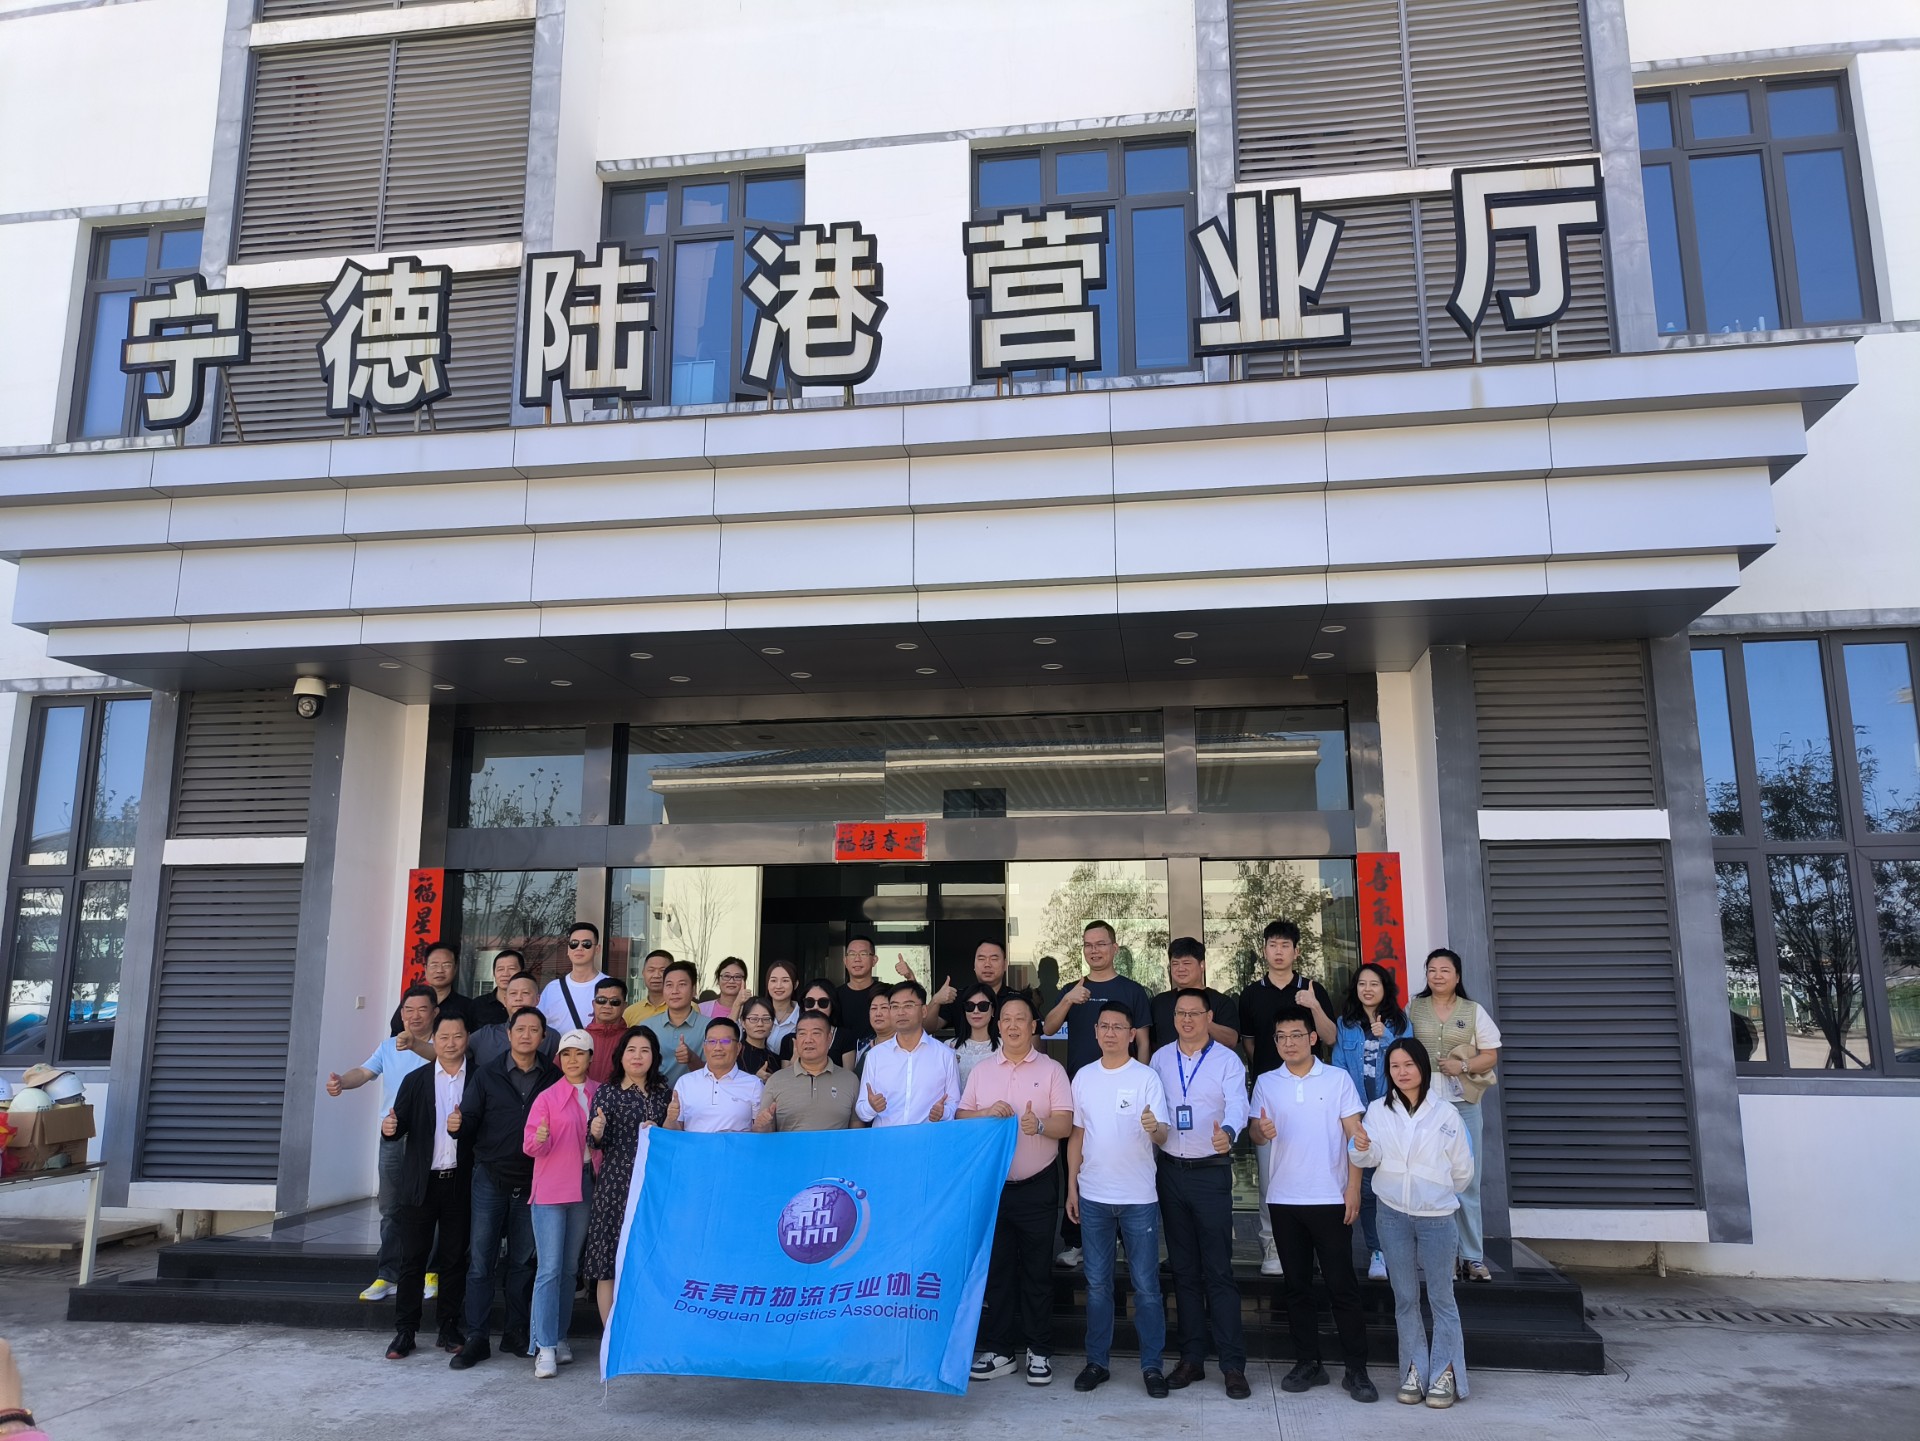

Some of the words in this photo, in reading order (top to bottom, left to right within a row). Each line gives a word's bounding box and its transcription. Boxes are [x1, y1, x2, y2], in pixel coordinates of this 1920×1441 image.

[121, 157, 1603, 429] 宁德陆港营业厅
[680, 1272, 942, 1307] 东莞市物流行业协会
[673, 1299, 760, 1322] Dongguan
[765, 1308, 837, 1325] Logistics
[840, 1302, 939, 1321] Association
